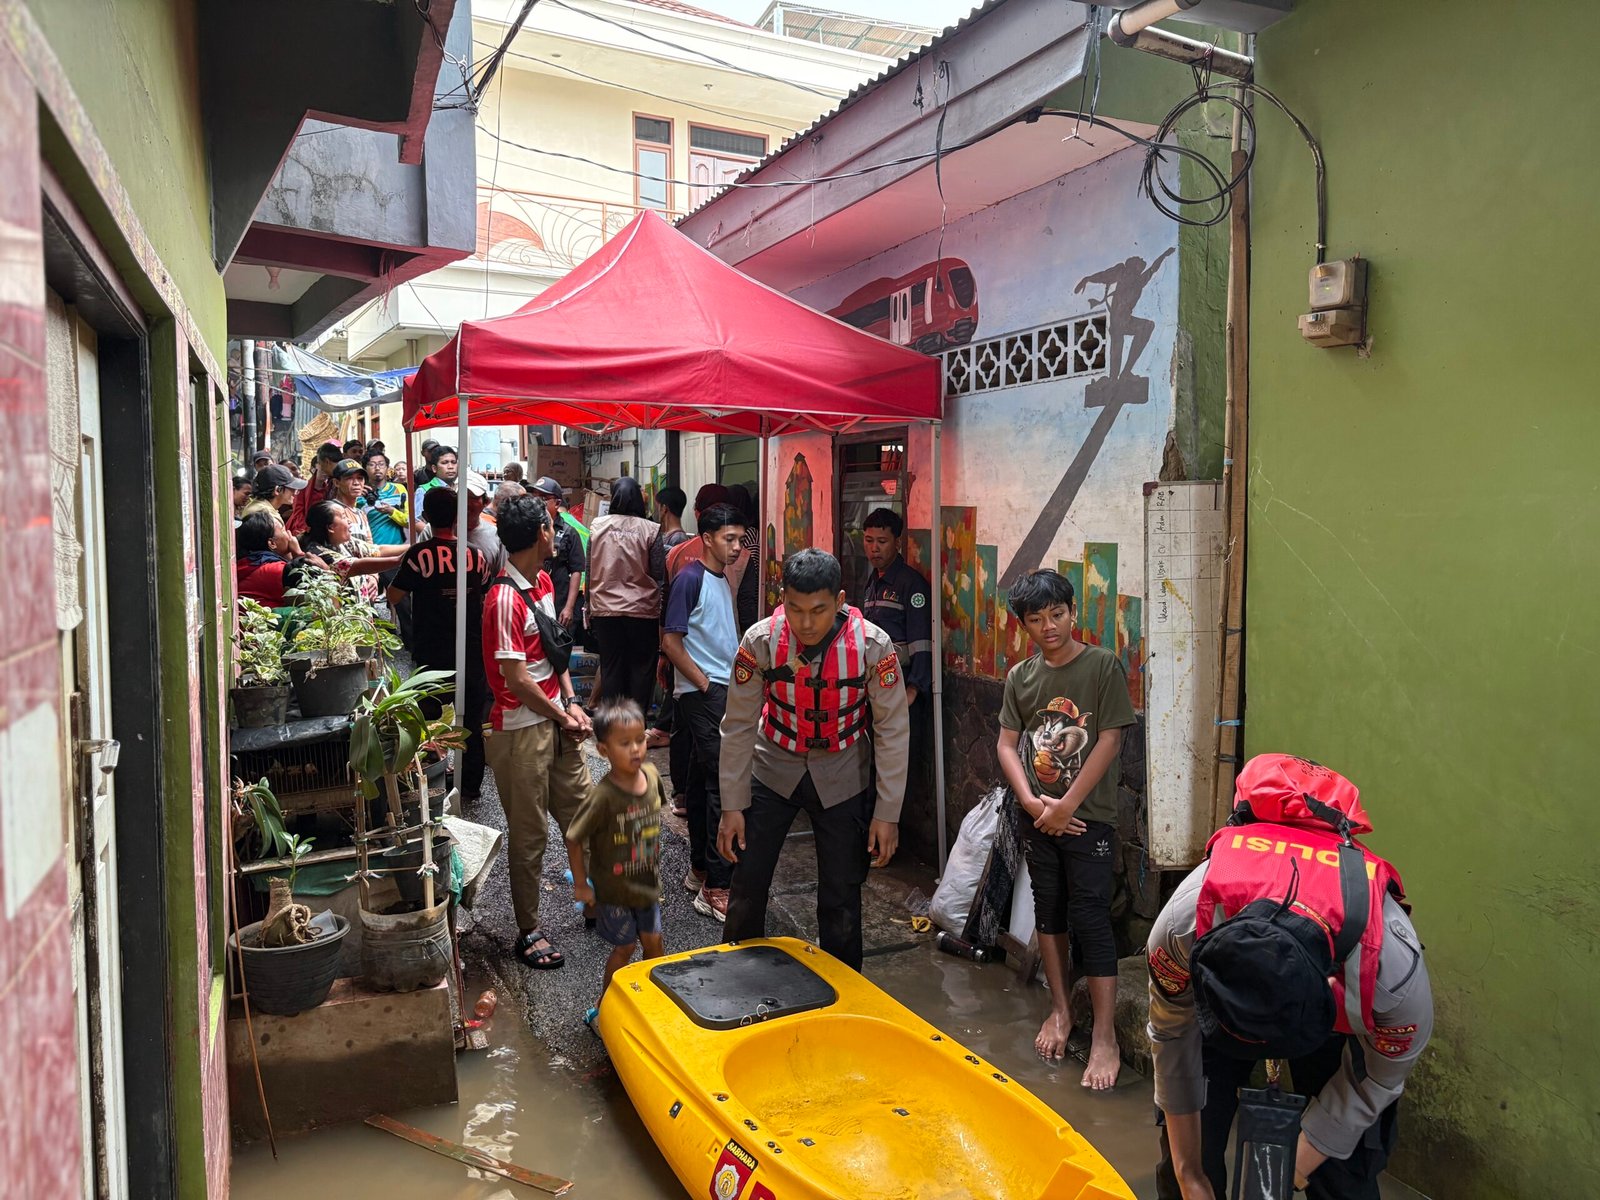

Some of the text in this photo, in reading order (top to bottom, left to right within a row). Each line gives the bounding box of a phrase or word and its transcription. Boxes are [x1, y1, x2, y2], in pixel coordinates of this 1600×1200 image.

[1156, 491, 1165, 507] RAB
[1156, 515, 1166, 532] Adm
[877, 654, 896, 669] POLDA
[726, 1142, 756, 1171] SABHARA
